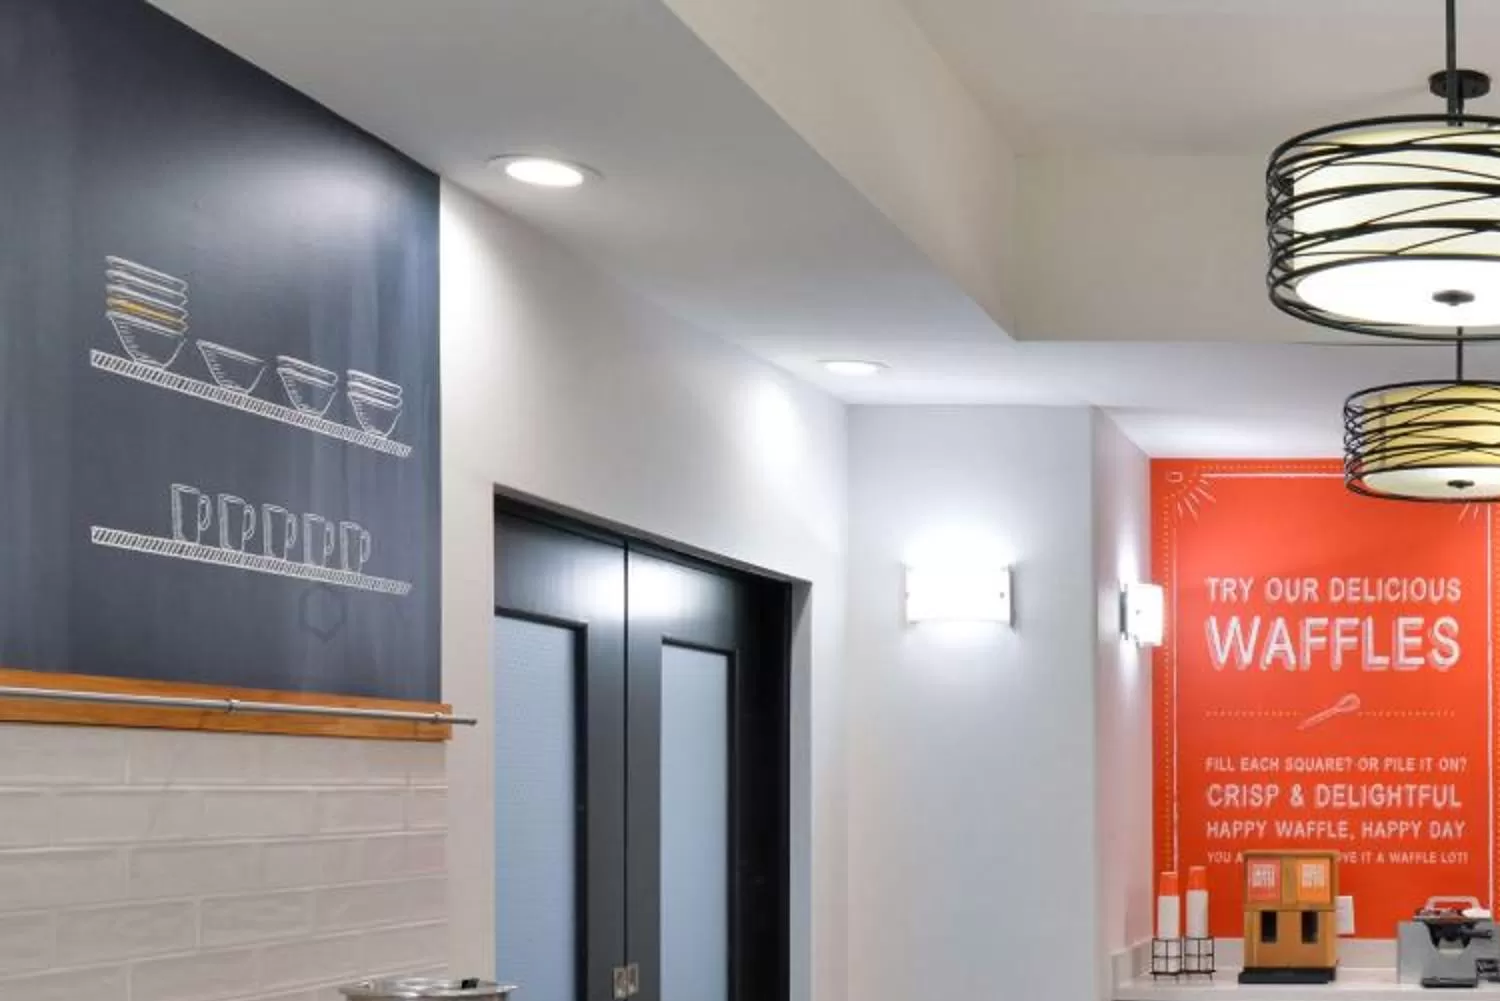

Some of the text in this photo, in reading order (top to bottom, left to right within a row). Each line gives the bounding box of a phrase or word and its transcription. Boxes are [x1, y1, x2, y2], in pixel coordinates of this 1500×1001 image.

[1204, 576, 1462, 602] TRY OUR DELICIOUS
[1203, 615, 1461, 672] WAFFLES
[1205, 756, 1467, 773] FILL EACH SQUARE? OR PILE IT ON?
[1206, 783, 1463, 809] CRISP & DELIGHTFUL
[1206, 820, 1466, 841] HAPPY WAFFLE, HAPPY DAY
[1207, 851, 1232, 864] YOU
[1376, 851, 1385, 864] A
[1388, 851, 1438, 864] WAFFLE
